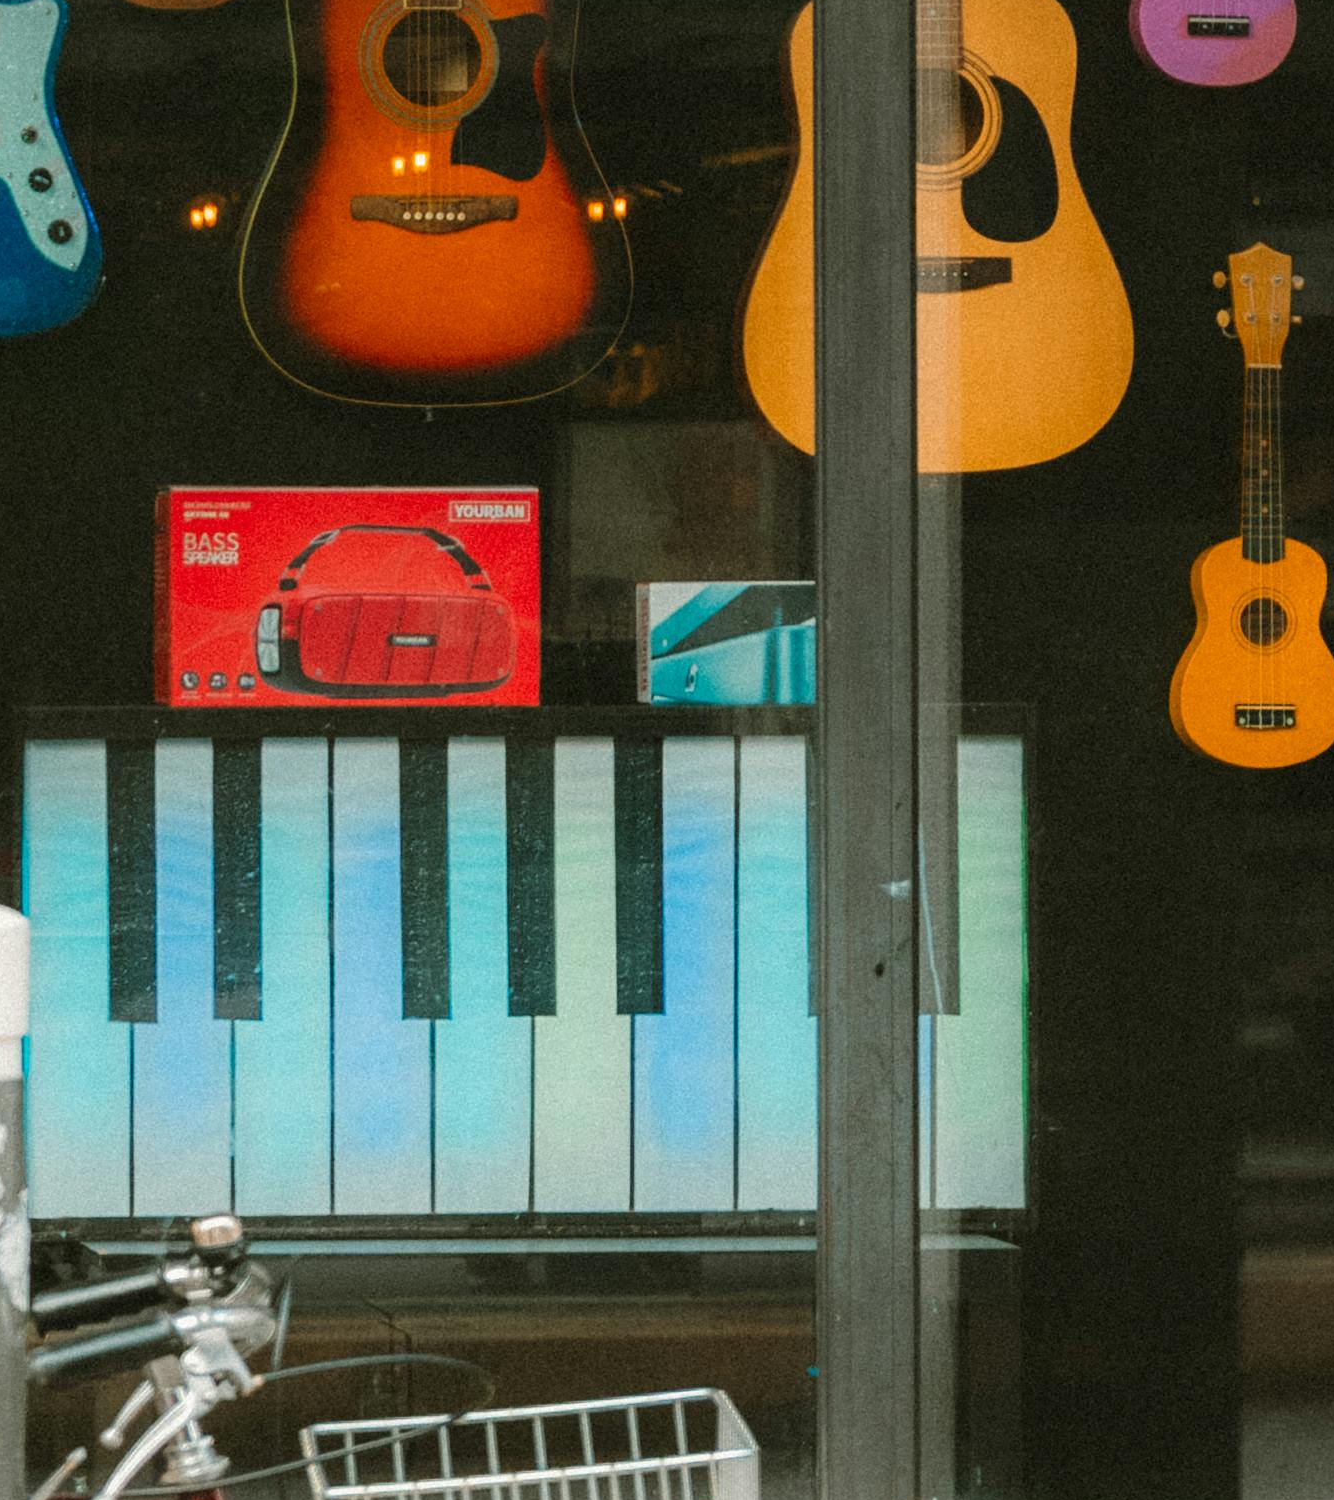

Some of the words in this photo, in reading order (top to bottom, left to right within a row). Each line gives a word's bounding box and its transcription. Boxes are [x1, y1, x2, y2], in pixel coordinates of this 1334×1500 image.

[454, 504, 525, 520] YOURBAN
[183, 532, 240, 551] BASS
[183, 551, 239, 565] SPEAKER
